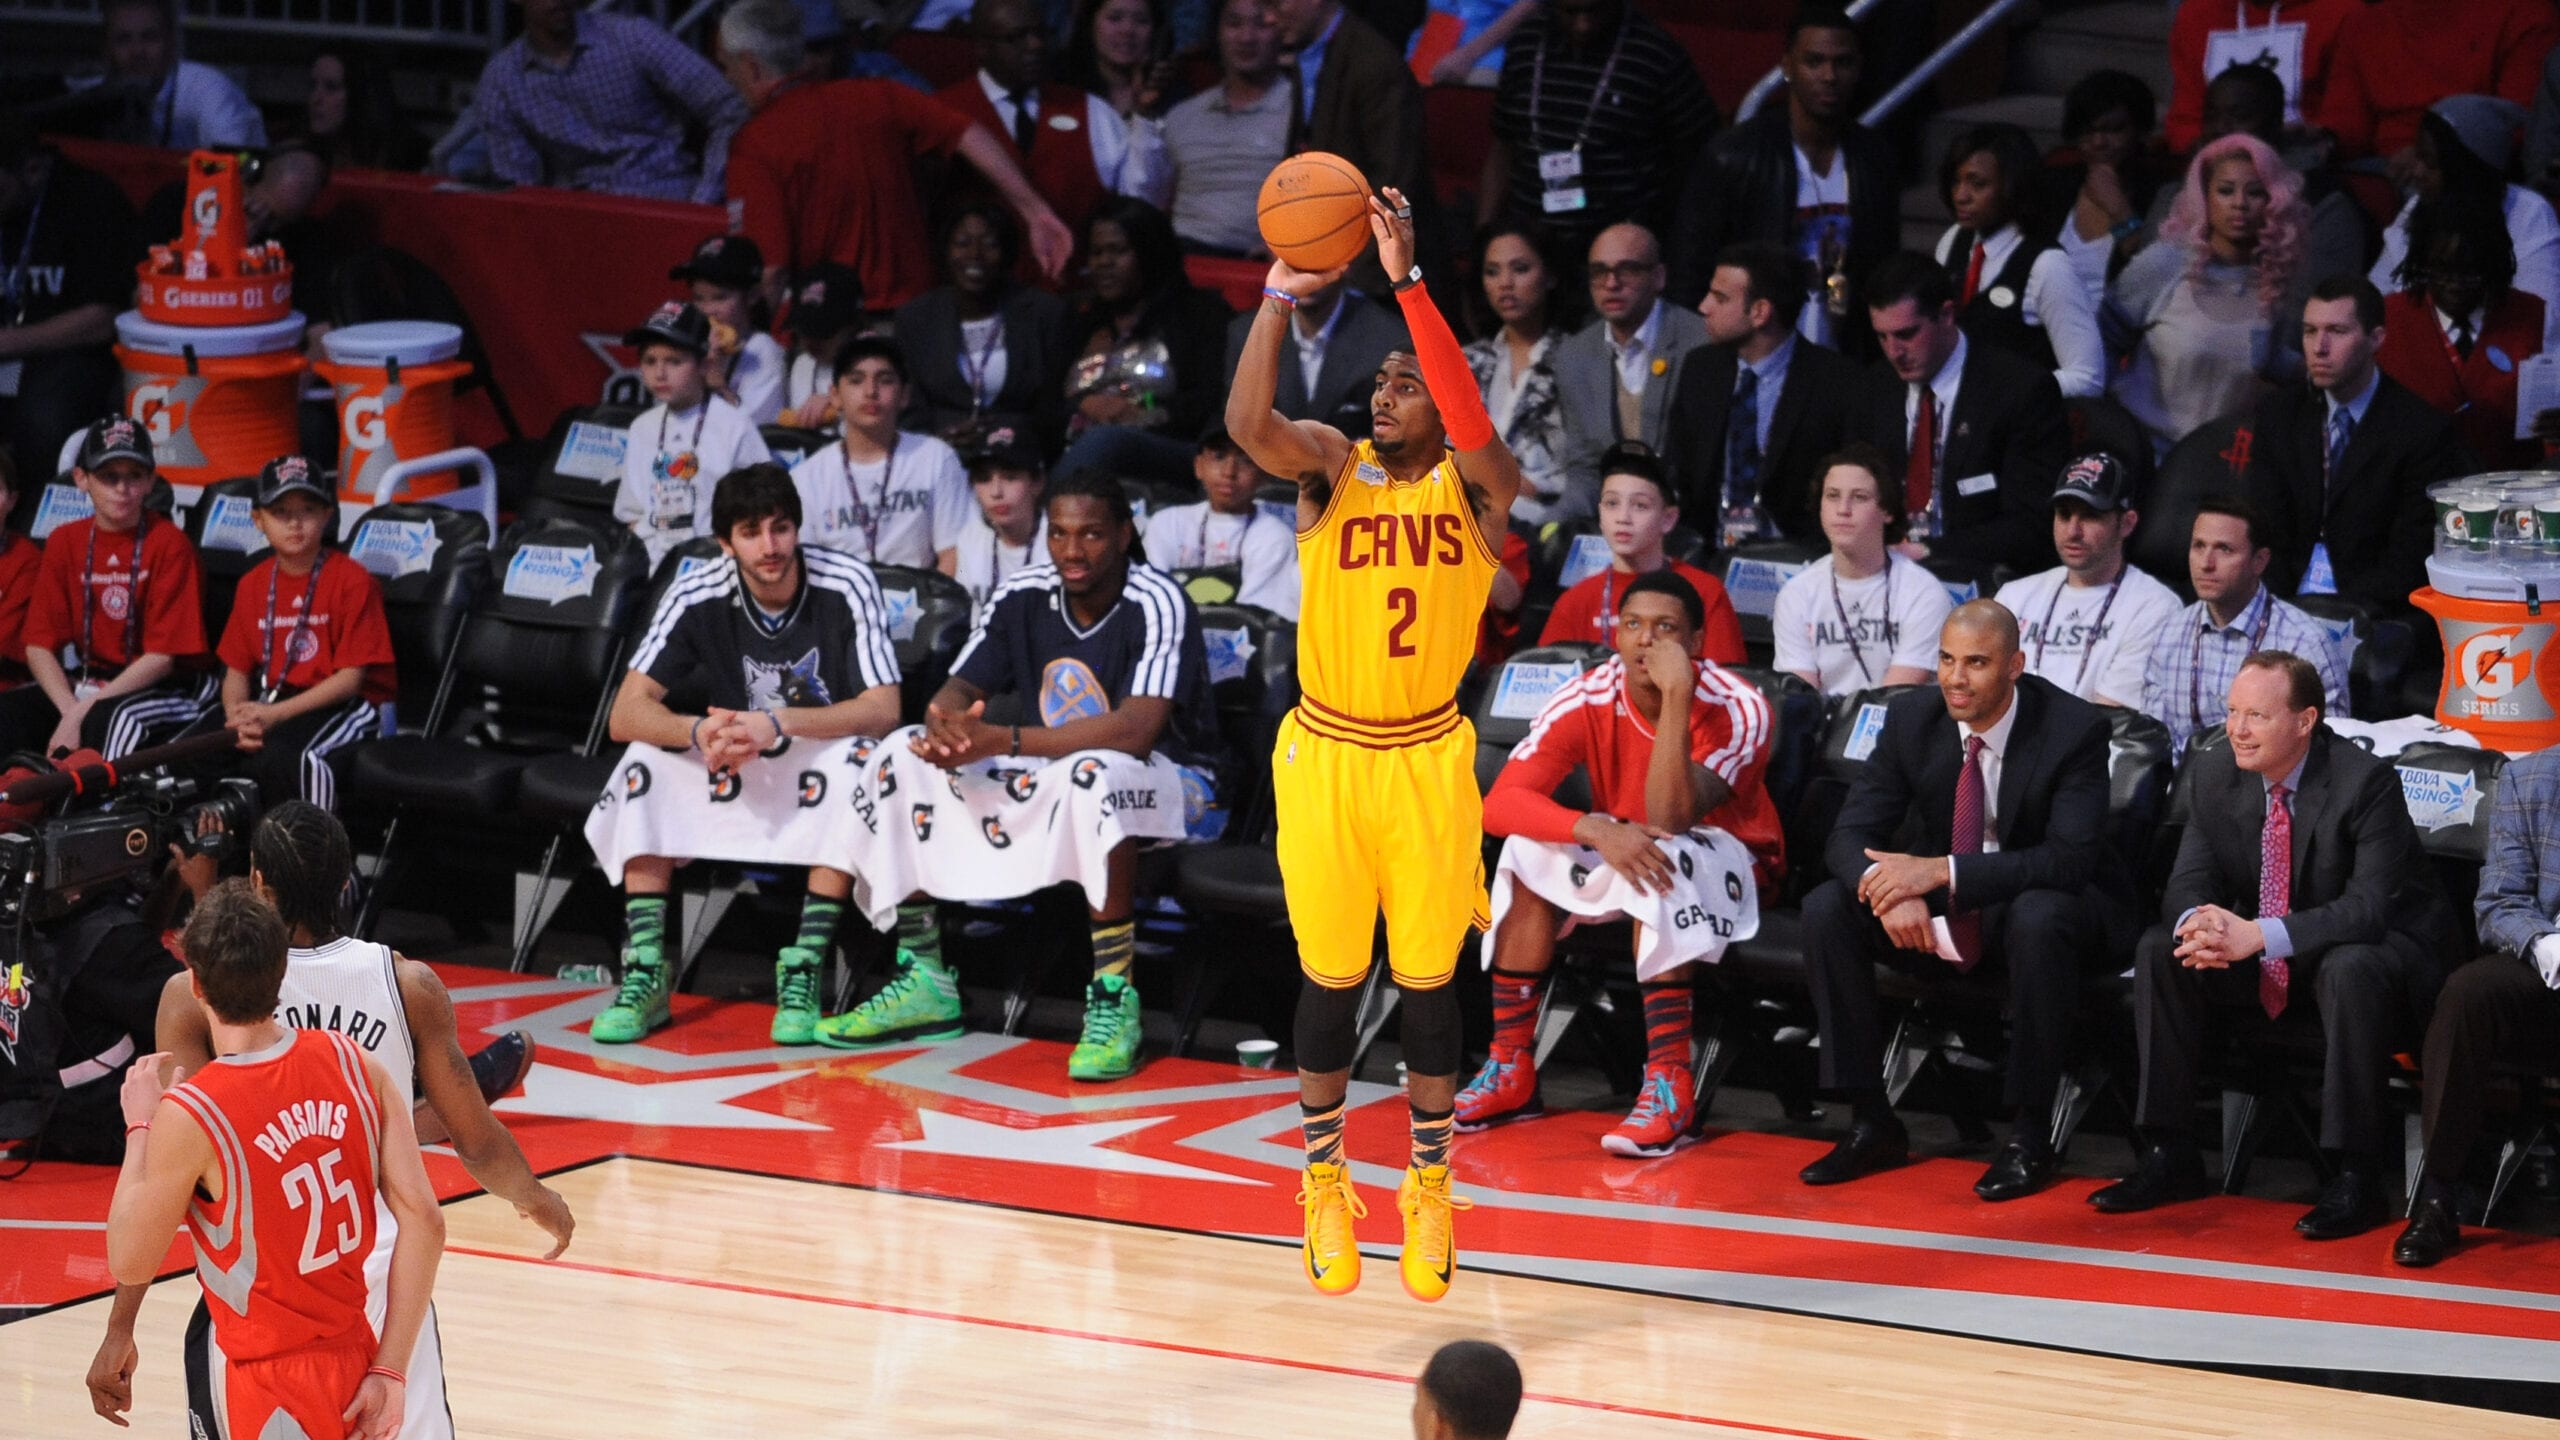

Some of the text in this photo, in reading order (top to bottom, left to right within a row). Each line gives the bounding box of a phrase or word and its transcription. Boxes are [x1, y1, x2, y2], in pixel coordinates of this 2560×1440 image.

[132, 385, 172, 443] G
[344, 396, 387, 450] G
[1338, 513, 1464, 571] CAVS
[1387, 587, 1418, 659] 2
[2461, 633, 2515, 699] G
[2461, 699, 2520, 716] SERIES
[798, 769, 828, 809] G
[2403, 769, 2441, 788] BBVA
[981, 815, 1012, 849] G
[254, 1099, 349, 1164] PARSONS
[280, 1146, 363, 1276] 25
